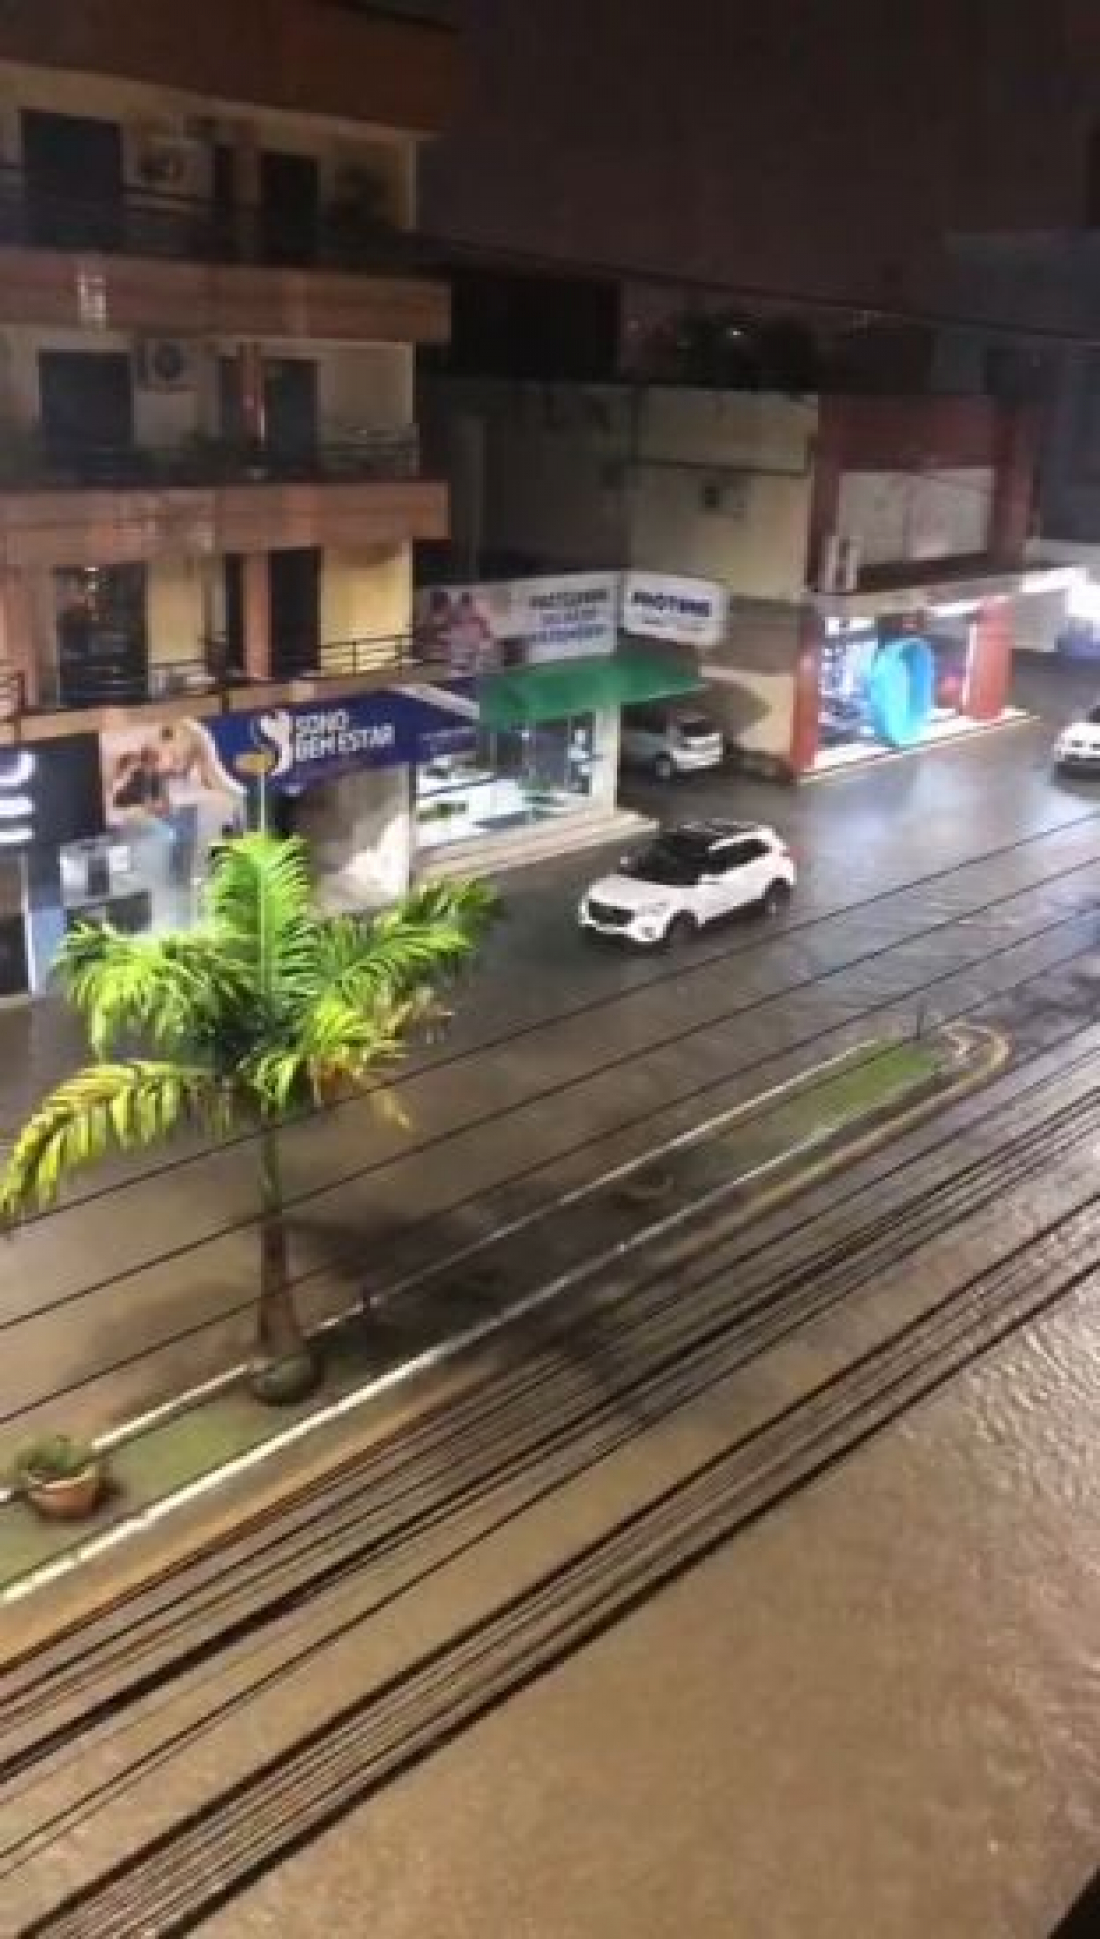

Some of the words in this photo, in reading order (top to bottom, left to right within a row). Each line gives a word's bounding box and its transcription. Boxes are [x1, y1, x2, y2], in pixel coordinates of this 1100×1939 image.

[296, 709, 350, 735] SONO
[296, 733, 336, 762] BEM
[338, 722, 395, 752] ESTAR
